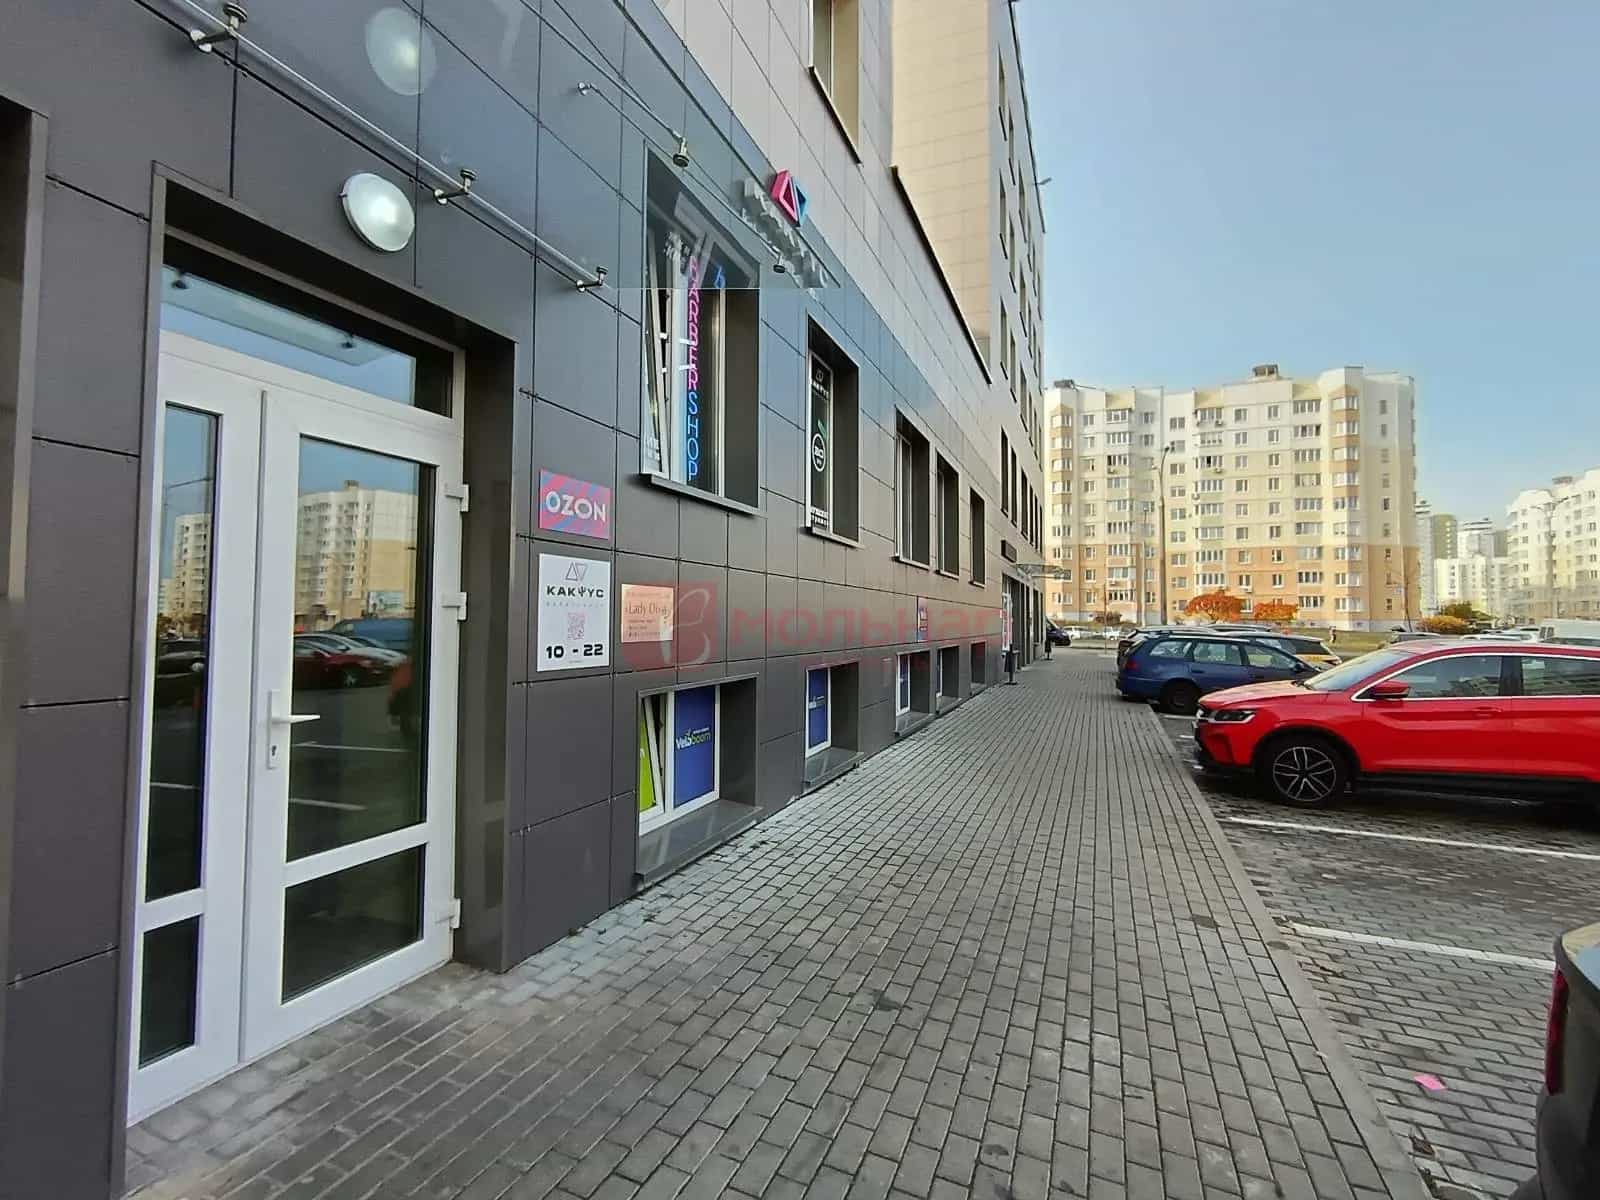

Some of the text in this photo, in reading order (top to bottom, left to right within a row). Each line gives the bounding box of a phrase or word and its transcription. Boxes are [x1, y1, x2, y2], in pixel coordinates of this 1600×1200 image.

[545, 490, 606, 523] OZON
[546, 645, 564, 659] 10
[583, 643, 603, 657] 22
